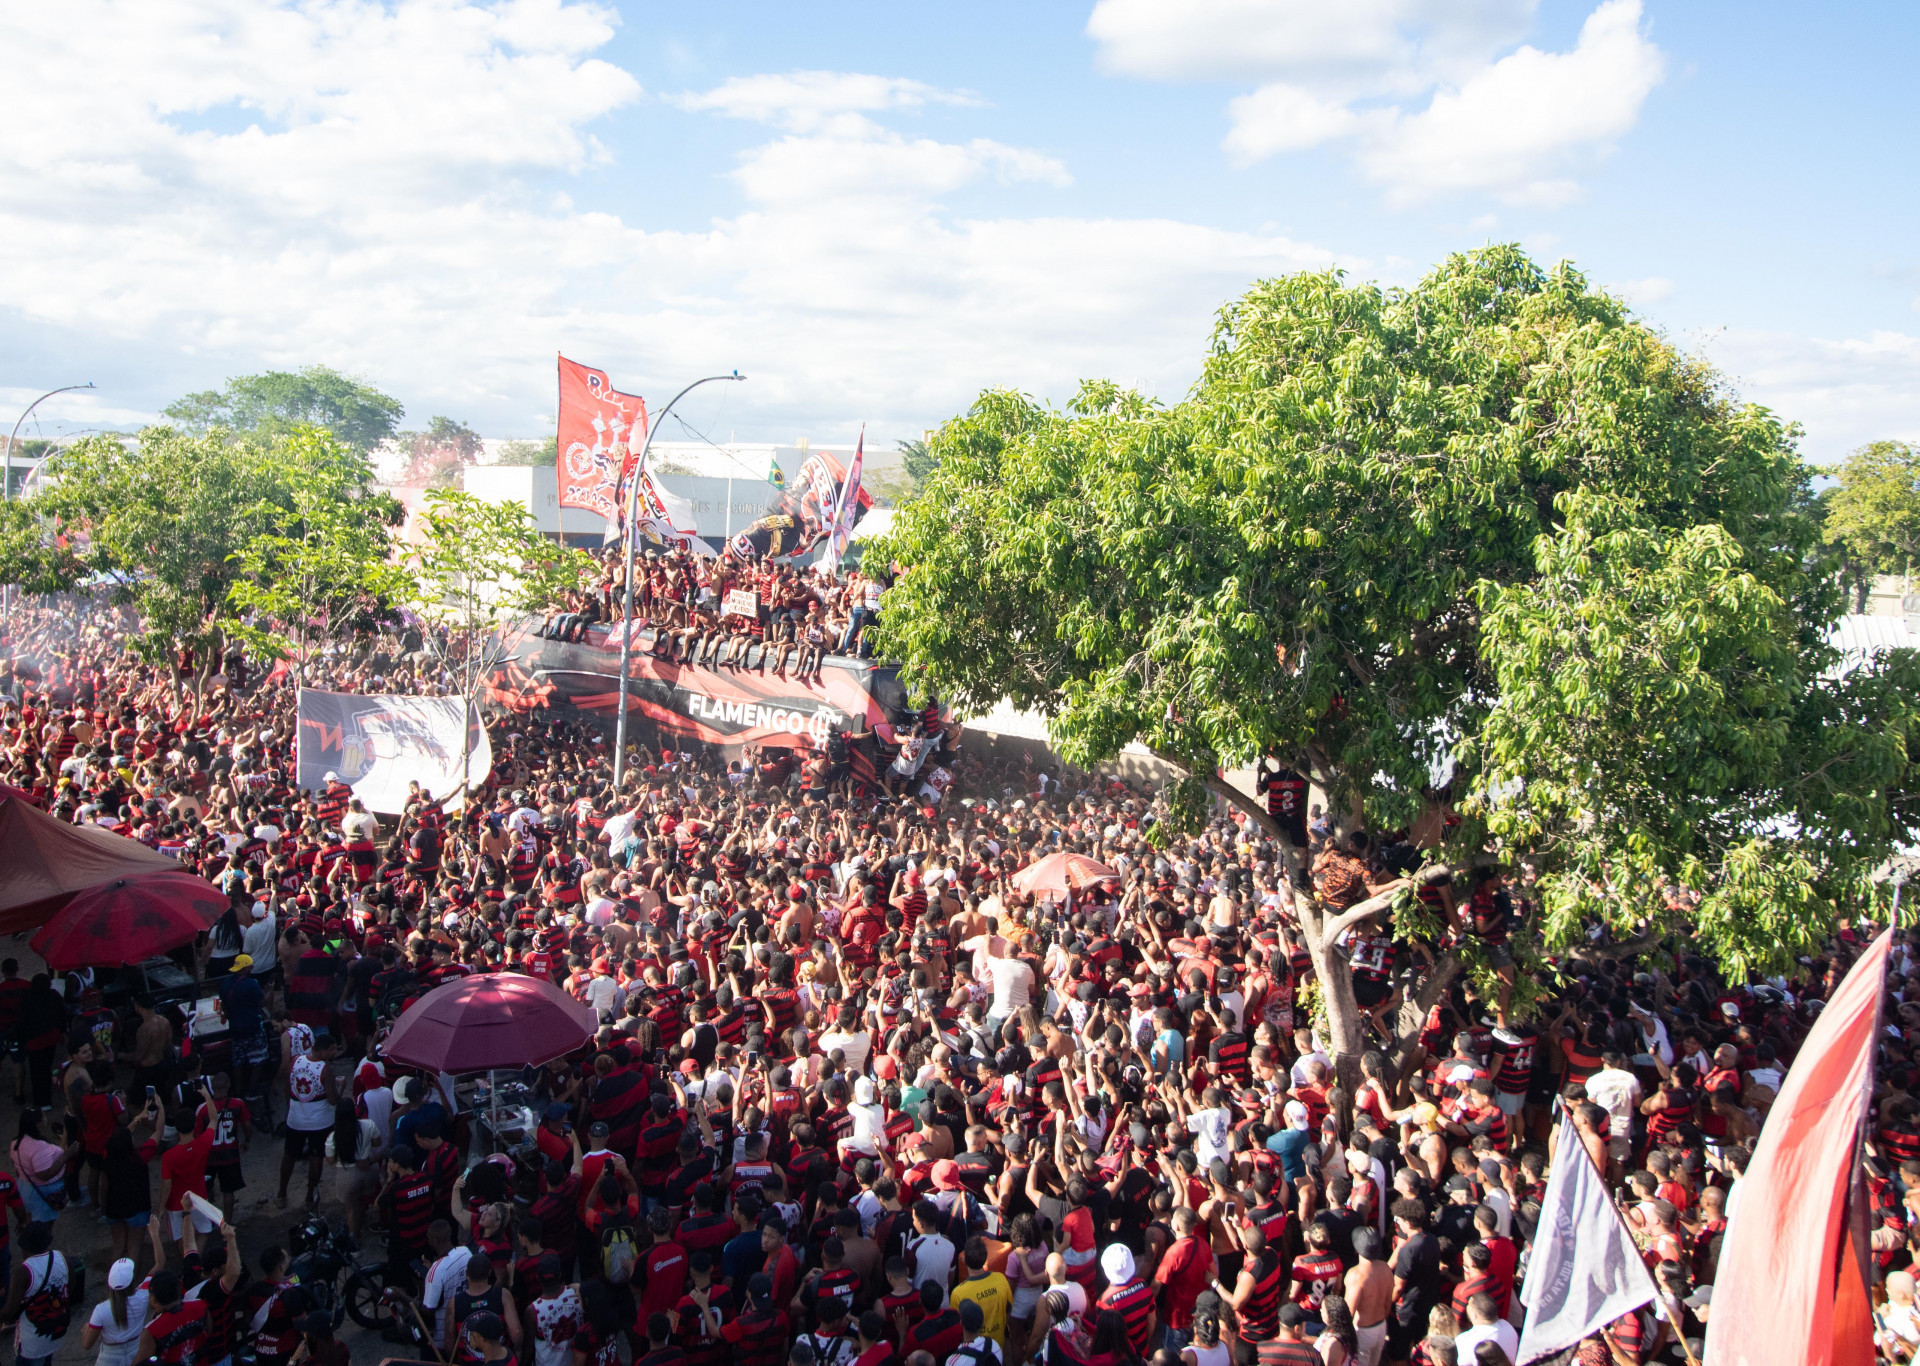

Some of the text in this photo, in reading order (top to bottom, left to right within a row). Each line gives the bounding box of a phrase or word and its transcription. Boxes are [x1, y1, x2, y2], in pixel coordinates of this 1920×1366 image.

[687, 693, 804, 735] FLAMENGO
[1282, 791, 1294, 810] 2
[976, 1287, 998, 1301] CASSIN
[1112, 1282, 1144, 1302] PETROBRAS
